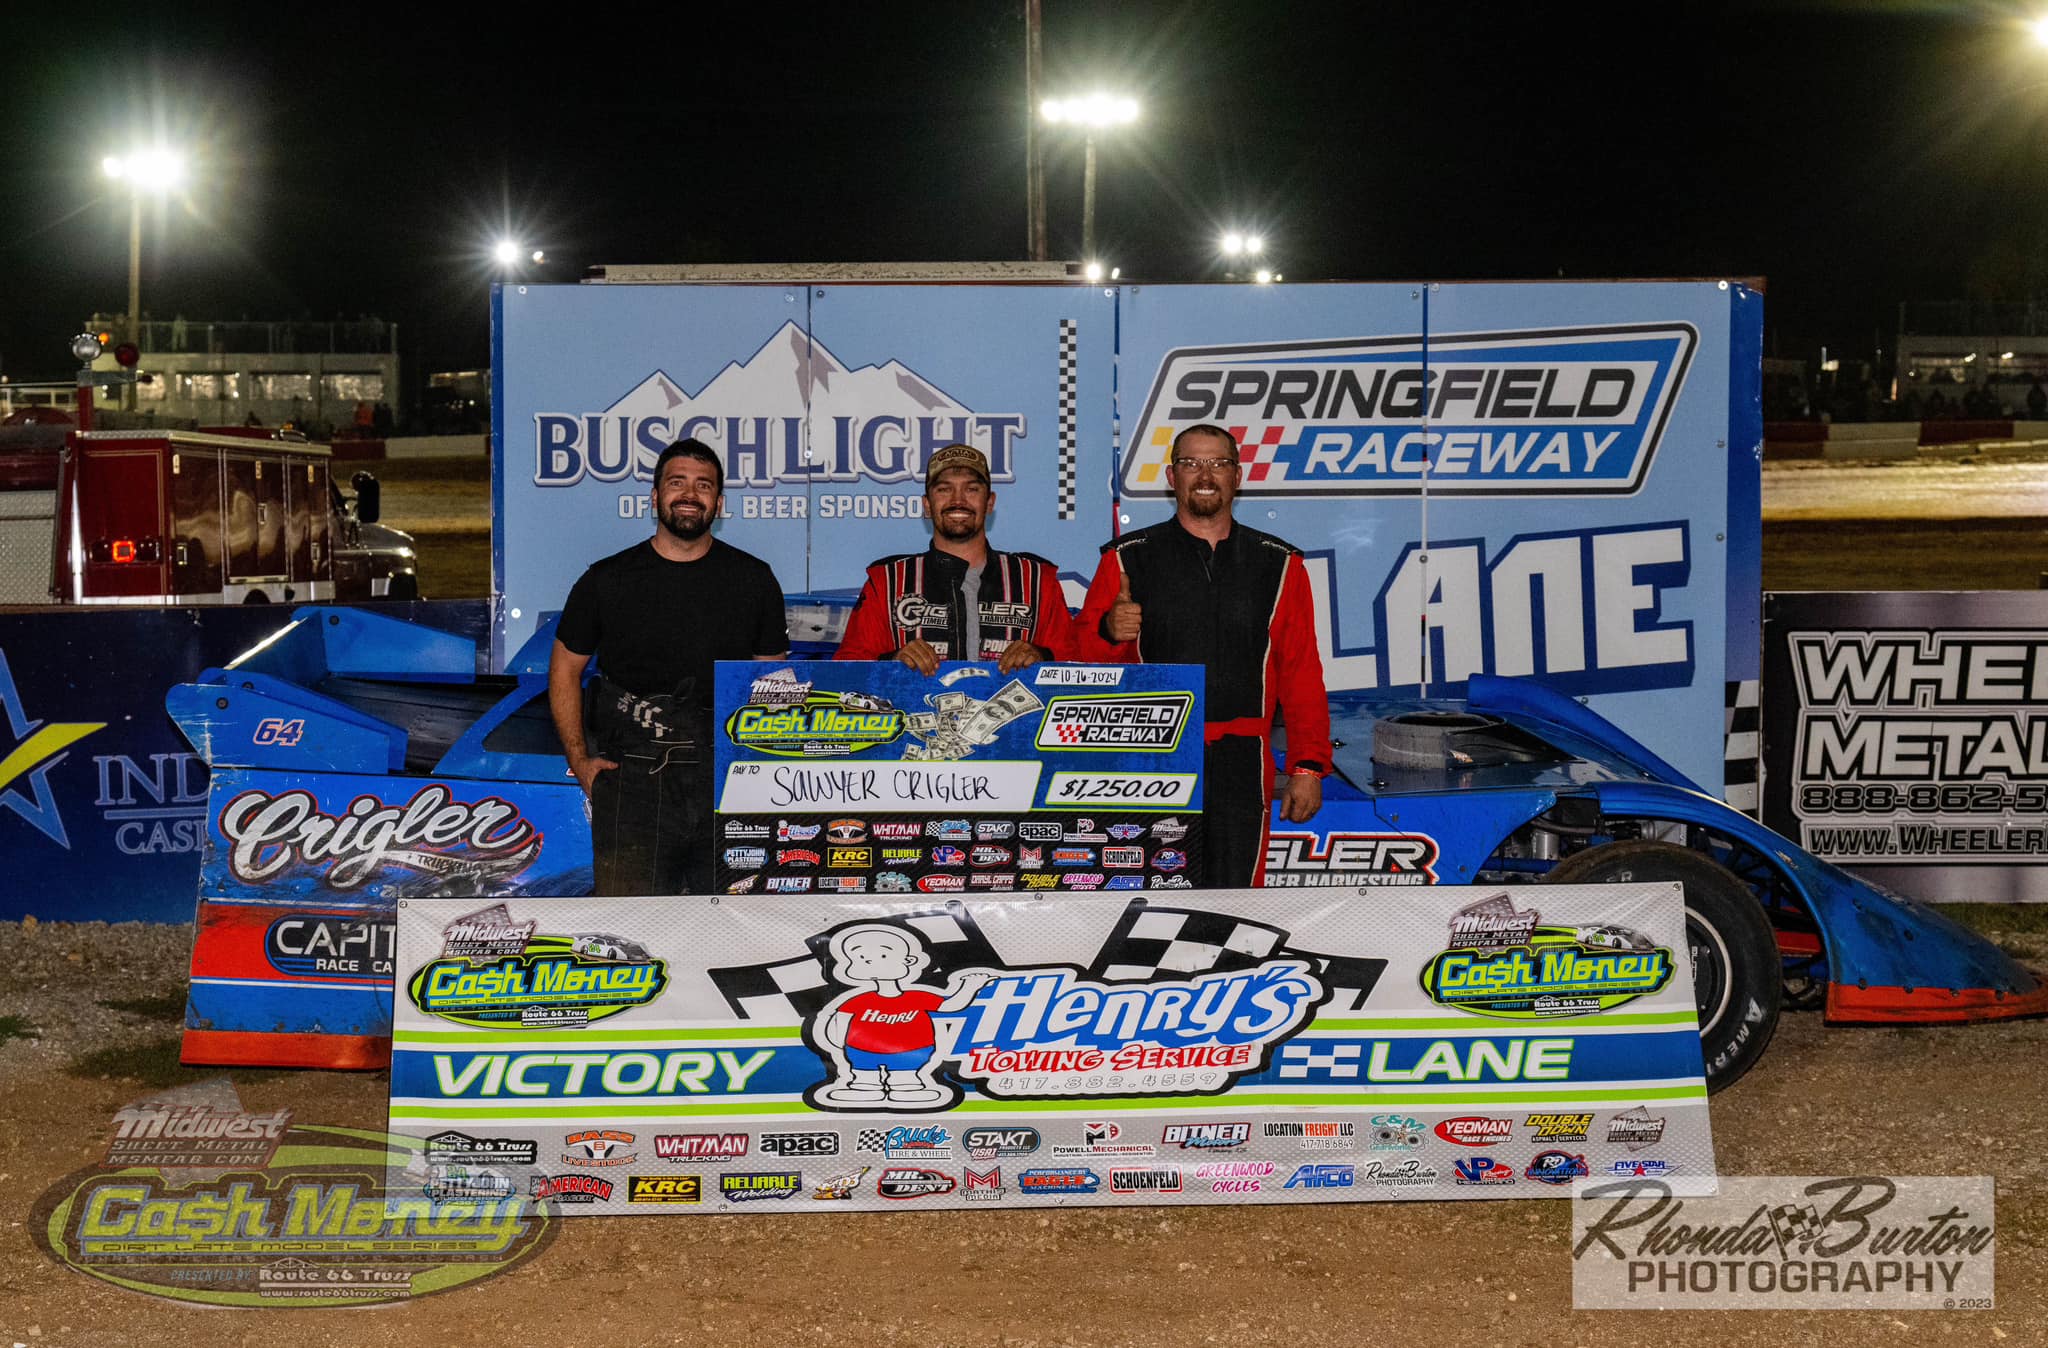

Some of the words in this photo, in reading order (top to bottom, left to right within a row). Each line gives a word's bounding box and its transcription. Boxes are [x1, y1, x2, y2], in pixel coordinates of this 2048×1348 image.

[1168, 368, 1635, 421] SPRINGFIELD
[1303, 430, 1621, 475] RACEWAY
[742, 495, 809, 519] BEER
[819, 495, 931, 519] SPONSO
[1302, 526, 1691, 693] LANE
[1039, 669, 1059, 679] DATE
[1802, 645, 2048, 700] WHE
[750, 679, 813, 694] Midwest
[812, 709, 900, 738] Money
[1051, 707, 1175, 724] SPRINGFIELD
[253, 717, 304, 746] 64
[1086, 727, 1170, 742] RACEWAY
[732, 765, 747, 775] PAY
[748, 764, 760, 775] TO
[893, 769, 999, 803] CRIGLER
[1059, 779, 1182, 800] $1,250.00
[1801, 784, 2048, 813] 888-862-5
[873, 824, 921, 835] WHITMAN
[978, 823, 1011, 833] STAKT
[1020, 827, 1058, 839] apac
[220, 787, 531, 888] Crigler
[1810, 824, 2048, 855] WWW.WHEELER
[726, 849, 766, 857] PETTYJOHN
[832, 851, 869, 860] KRC
[766, 877, 812, 889] BITNER
[924, 878, 964, 887] YEOMAN
[1451, 914, 1538, 933] Midwest
[446, 922, 534, 942] Midwest
[316, 959, 360, 972] RACE
[372, 961, 394, 973] CA
[1541, 951, 1667, 987] Money
[533, 963, 658, 998] Money
[966, 964, 1312, 1048] Henry's
[1534, 1000, 1560, 1008] Route
[1576, 999, 1600, 1007] Truss
[522, 1010, 548, 1018] Route
[566, 1009, 588, 1017] Truss
[860, 1007, 917, 1026] Henry
[969, 1046, 1104, 1073] TOWING
[1110, 1044, 1251, 1071] SERVICE
[1367, 1038, 1575, 1082] LANE
[433, 1049, 776, 1096] VICTORY
[998, 1072, 1220, 1091] 417.882.4559
[1445, 1119, 1511, 1136] YEOMAN
[1526, 1114, 1594, 1126] DOUBLE
[1609, 1117, 1665, 1132] Midwest
[1165, 1124, 1249, 1144] BITNER
[1264, 1123, 1304, 1137] LOCATION
[1305, 1123, 1338, 1137] FREIGHT
[1340, 1123, 1354, 1136] LLC
[1482, 1134, 1513, 1142] ENGINES
[1538, 1125, 1588, 1137] DOWN
[429, 1142, 471, 1151] Route
[475, 1142, 494, 1151] 66
[498, 1142, 533, 1151] Truss
[656, 1137, 747, 1154] WHITMAN
[760, 1137, 834, 1156] apac
[968, 1131, 1032, 1147] STAKT
[890, 1150, 910, 1158] TIRE
[911, 1150, 918, 1158] &
[920, 1150, 951, 1158] WHEEL
[1196, 1162, 1275, 1178] GREENWOOD
[1454, 1157, 1496, 1181] VP
[1614, 1161, 1637, 1170] FIVE
[1641, 1160, 1665, 1169] STAR
[724, 1176, 798, 1189] RELIABLE
[886, 1171, 924, 1180] MR.
[1024, 1175, 1086, 1187] EAGLE
[1113, 1171, 1179, 1189] SCHOENFELD
[1283, 1165, 1355, 1189] AFCO
[1376, 1178, 1434, 1186] PHOTOGRAPHY
[537, 1175, 614, 1200] AMERICAN
[634, 1181, 697, 1193] KRC
[729, 1187, 793, 1199] Welding
[895, 1183, 953, 1193] DENT
[1212, 1180, 1261, 1193] CYCLES
